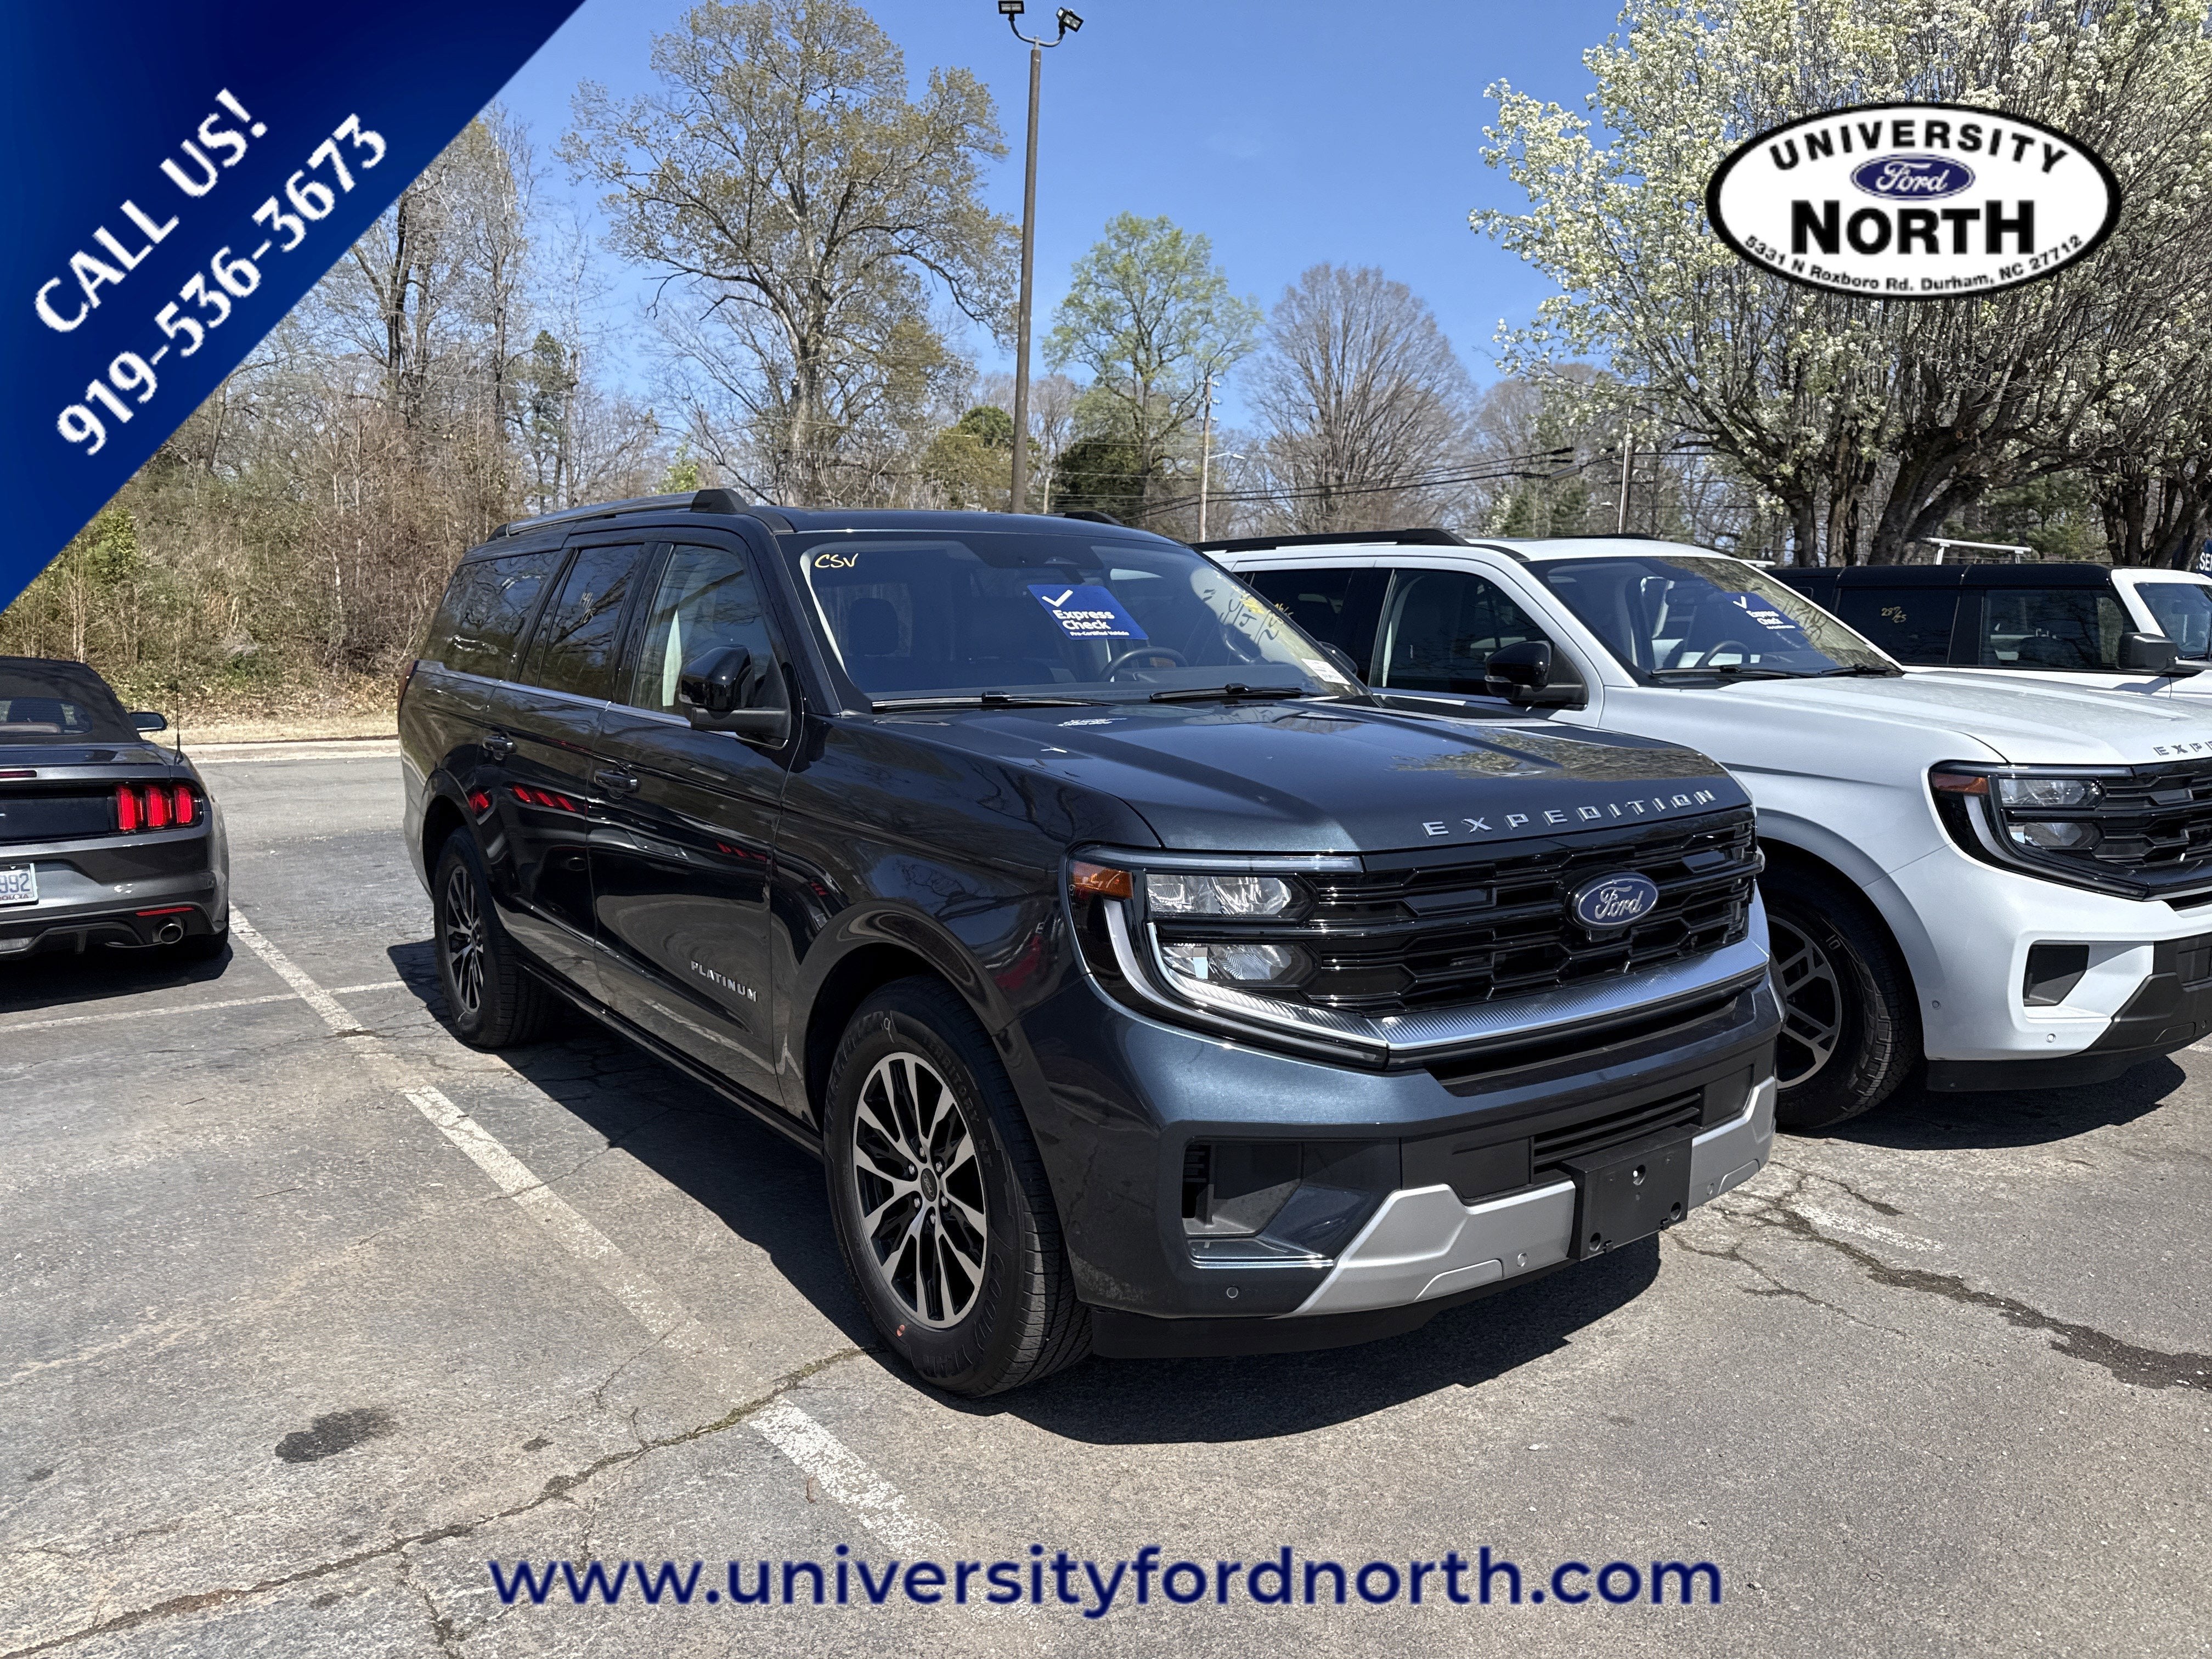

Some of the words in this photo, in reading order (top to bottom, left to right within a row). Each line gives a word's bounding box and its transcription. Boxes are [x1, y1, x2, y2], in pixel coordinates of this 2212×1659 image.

[815, 553, 859, 568] CSV
[1052, 610, 1115, 620] Express
[1062, 620, 1111, 630] Check
[1421, 789, 1717, 838] EXPEDITION
[1594, 885, 1644, 919] Ford
[691, 960, 757, 1002] PLATINUM
